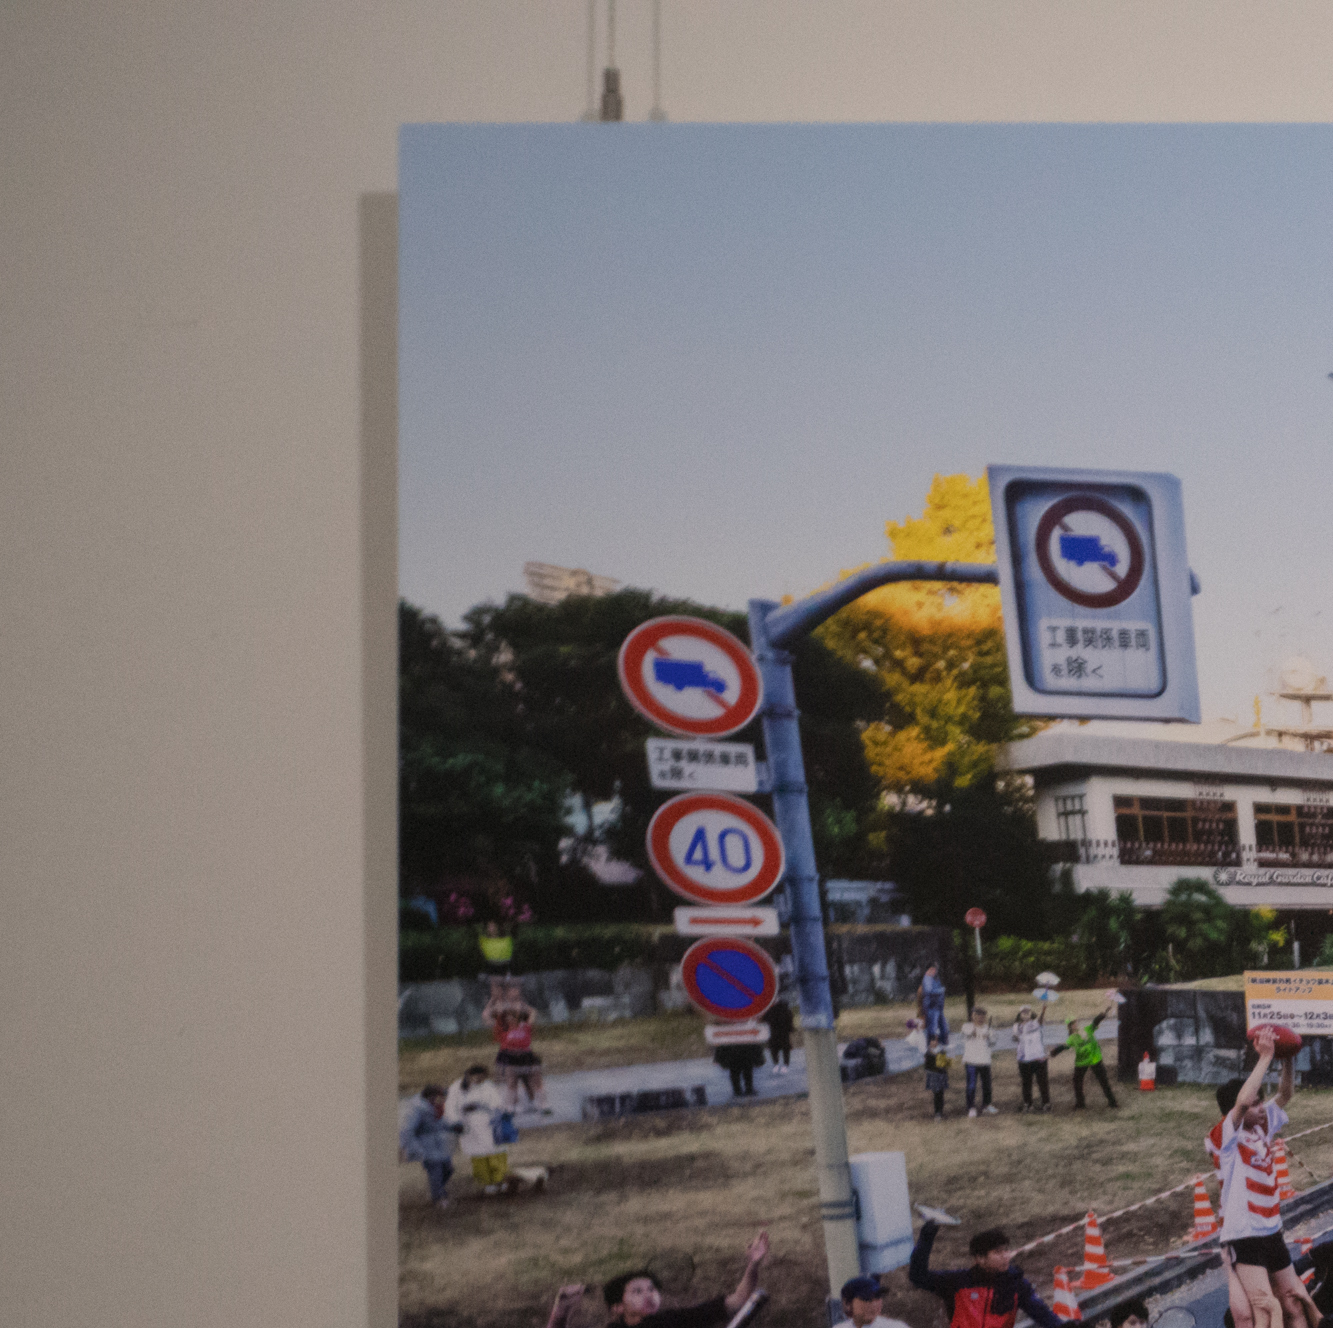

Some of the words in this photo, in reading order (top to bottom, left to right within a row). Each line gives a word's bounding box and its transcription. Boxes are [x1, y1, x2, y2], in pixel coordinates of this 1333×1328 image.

[1047, 625, 1151, 651] 工事関係車両
[1050, 656, 1103, 679] を除く
[684, 825, 752, 875] 40
[1235, 870, 1270, 887] Royal
